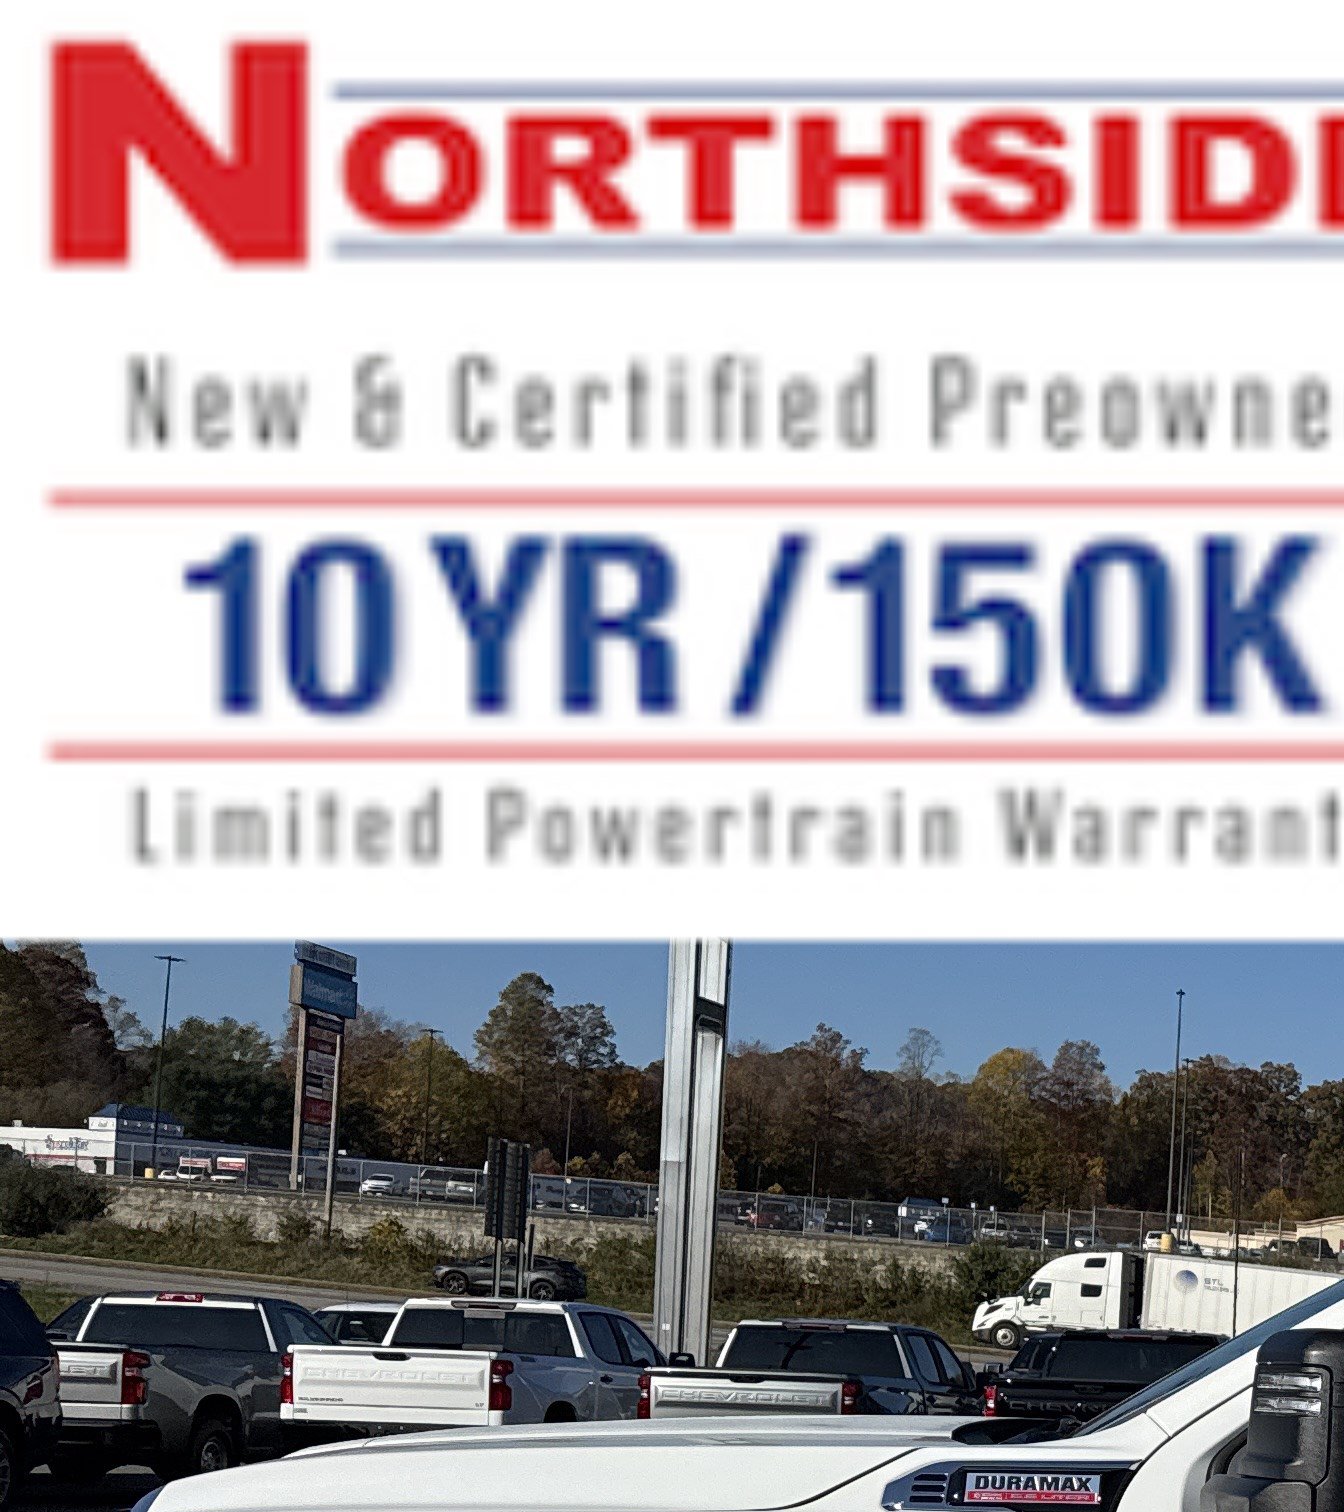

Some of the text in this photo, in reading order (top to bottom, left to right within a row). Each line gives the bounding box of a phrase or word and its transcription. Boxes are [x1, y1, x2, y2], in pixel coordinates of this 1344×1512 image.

[304, 1367, 474, 1383] CHEVROLET
[661, 1389, 828, 1406] CHEVROLET
[975, 1475, 1092, 1492] DURAMAX
